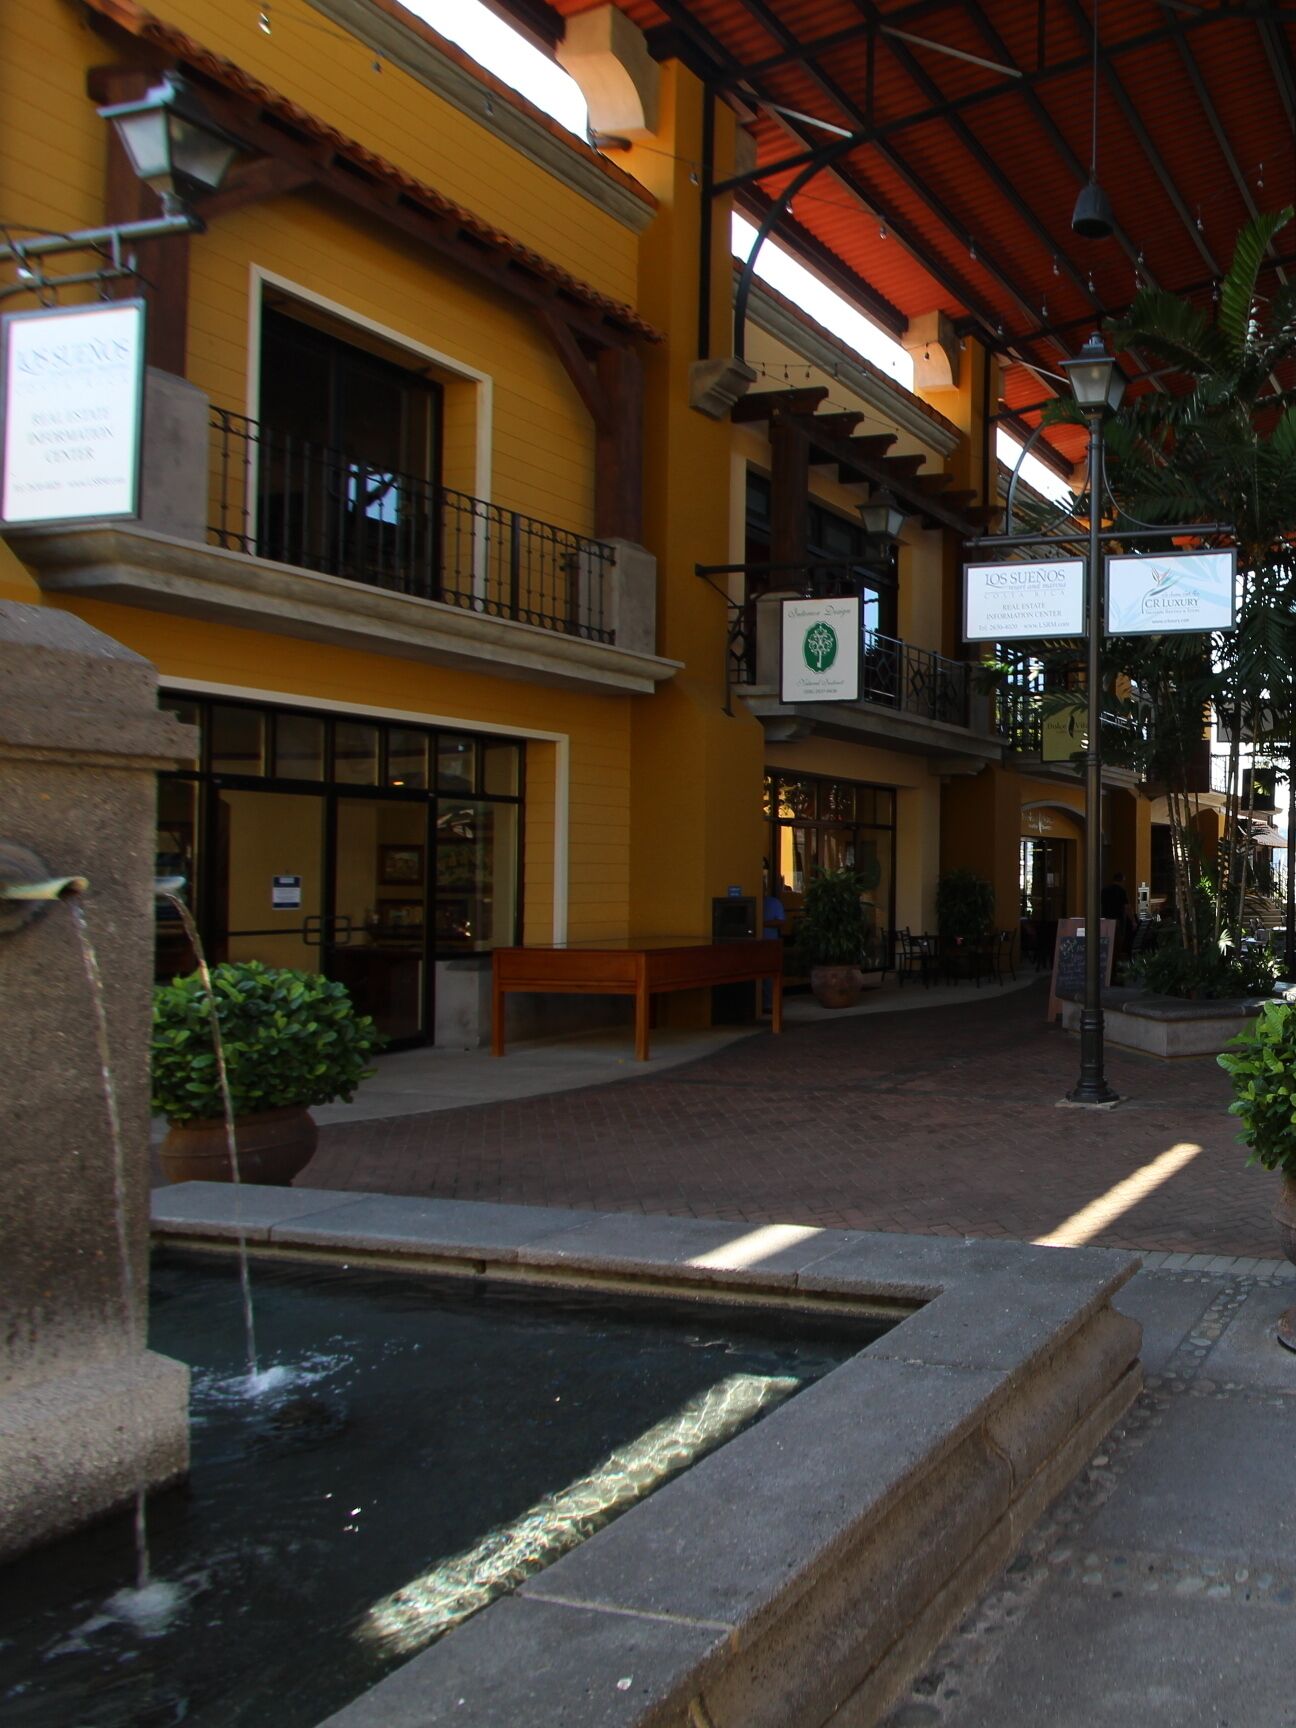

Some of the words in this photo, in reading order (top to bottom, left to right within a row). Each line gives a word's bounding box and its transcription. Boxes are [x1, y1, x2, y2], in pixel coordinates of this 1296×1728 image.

[985, 572, 1008, 587] LOS
[1009, 568, 1066, 584] SUEÑOS
[1002, 603, 1019, 611] REAL
[1162, 597, 1199, 607] LUXURY
[986, 611, 1033, 620] INFORMATION
[1034, 609, 1062, 618] CENTER
